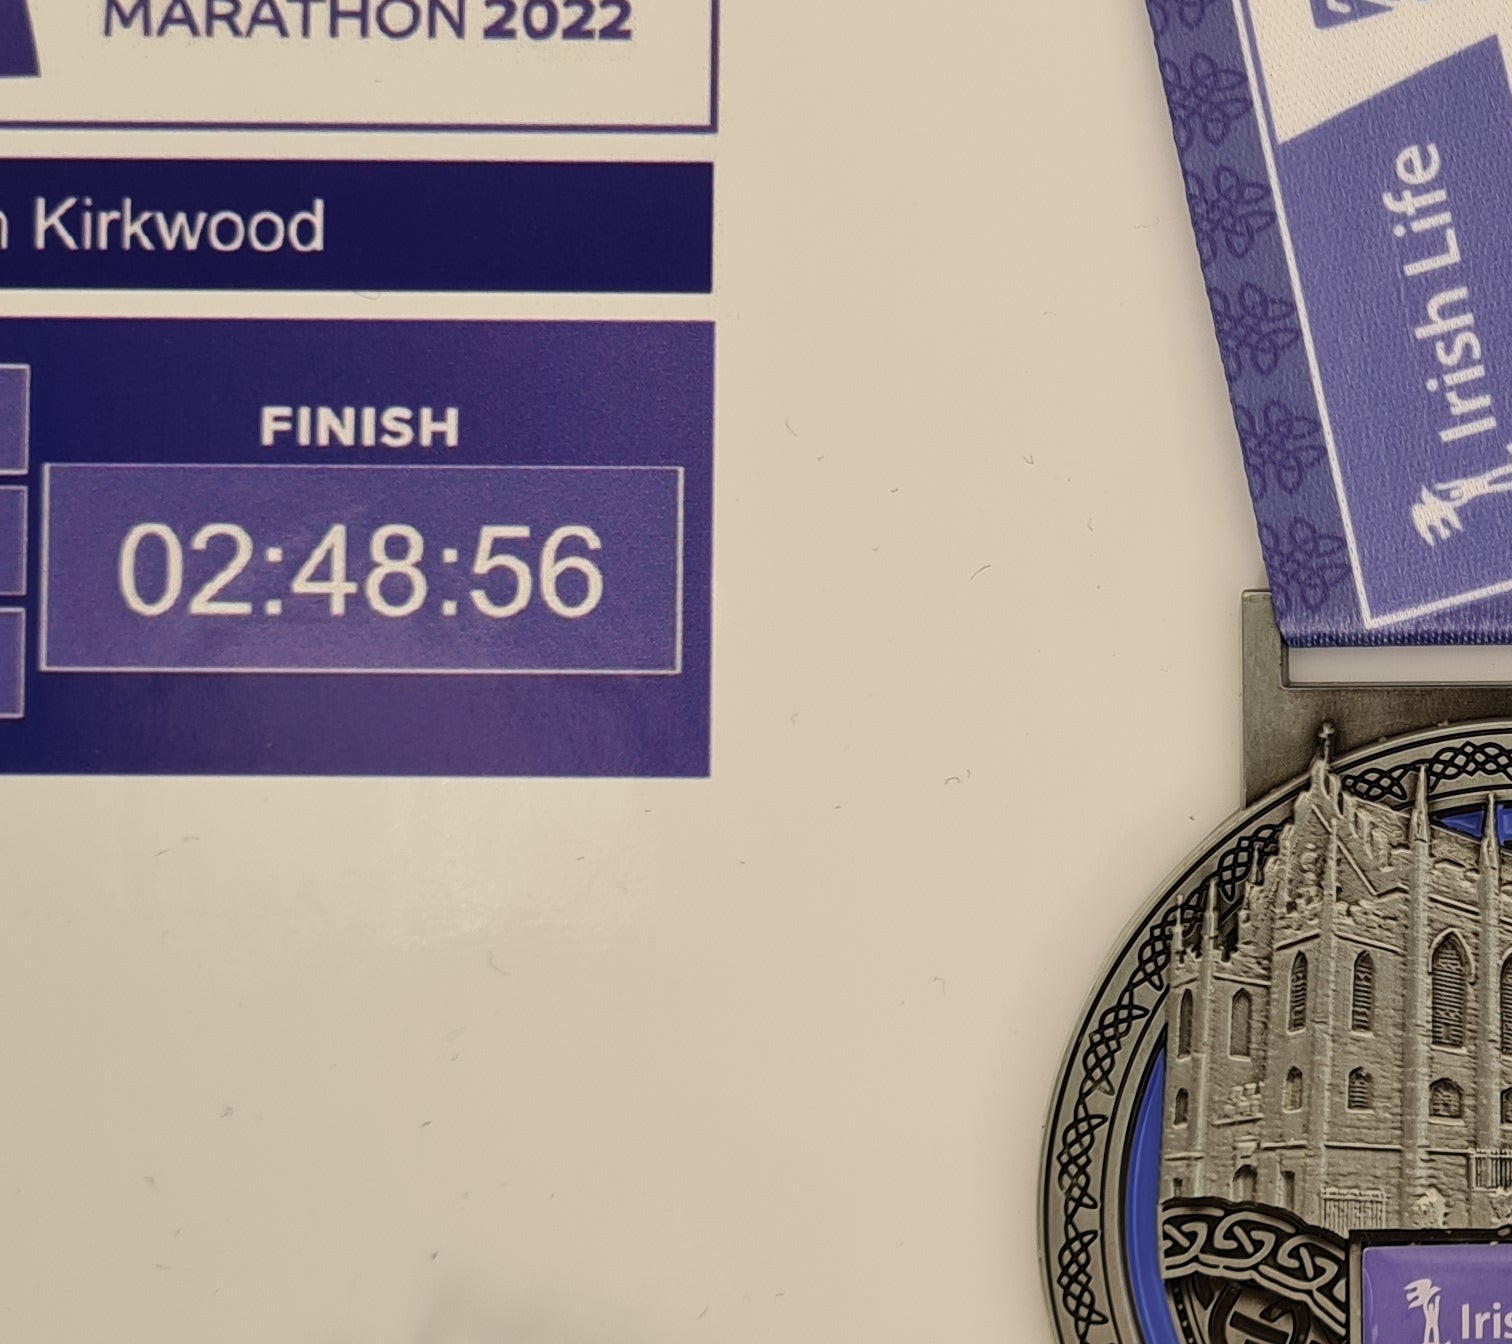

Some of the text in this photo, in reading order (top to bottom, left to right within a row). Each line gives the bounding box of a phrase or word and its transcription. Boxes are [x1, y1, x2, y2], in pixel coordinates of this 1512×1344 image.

[34, 196, 325, 252] Kirkwood
[1382, 142, 1497, 443] Irish Life
[261, 405, 459, 448] FINISH
[119, 522, 603, 619] 02:48:56
